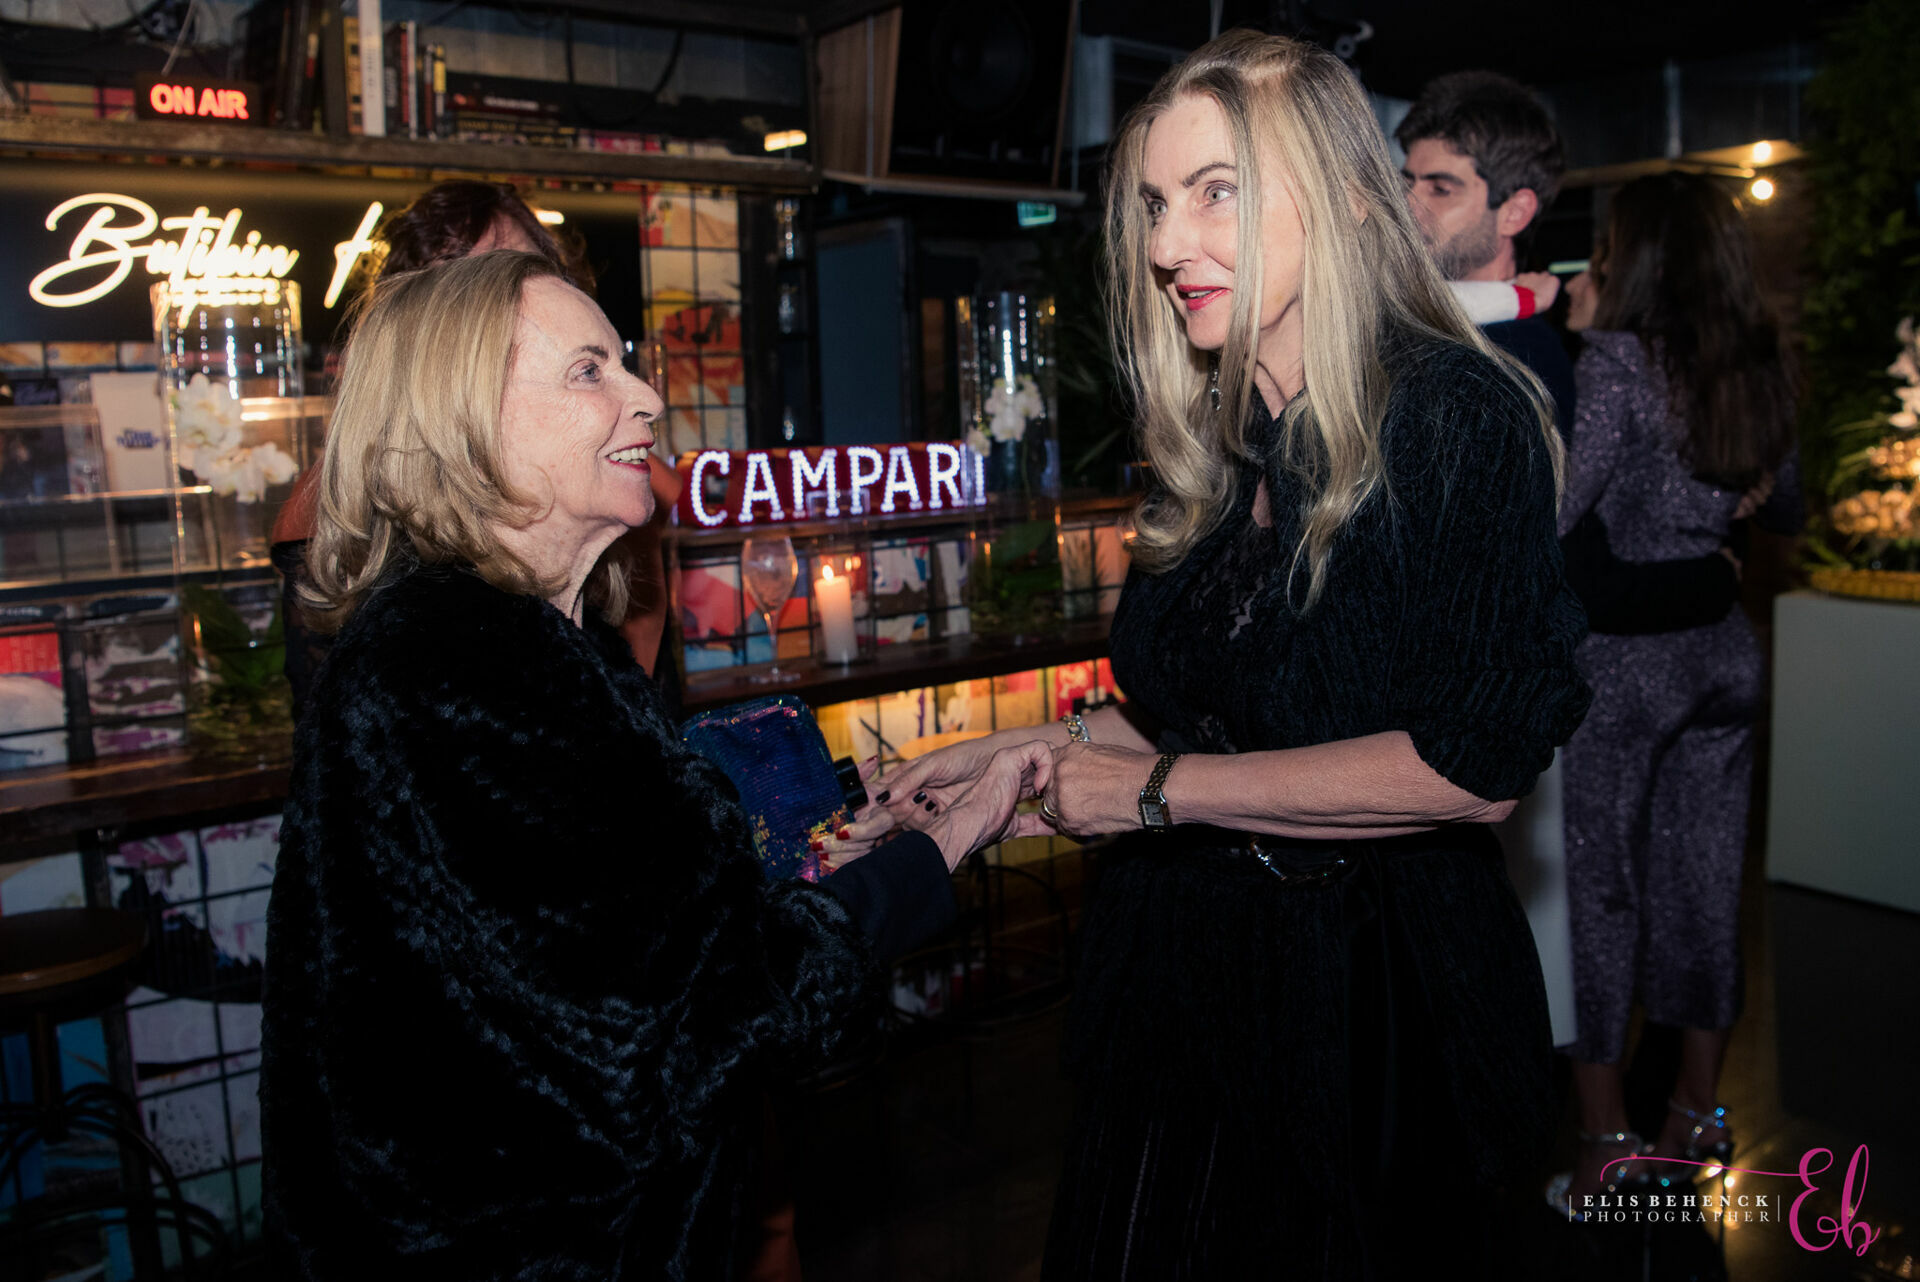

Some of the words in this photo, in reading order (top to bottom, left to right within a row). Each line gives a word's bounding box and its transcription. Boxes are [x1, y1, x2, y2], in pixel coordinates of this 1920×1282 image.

[150, 83, 195, 115] ON
[197, 88, 249, 119] AIR
[690, 442, 987, 527] CAMPARI
